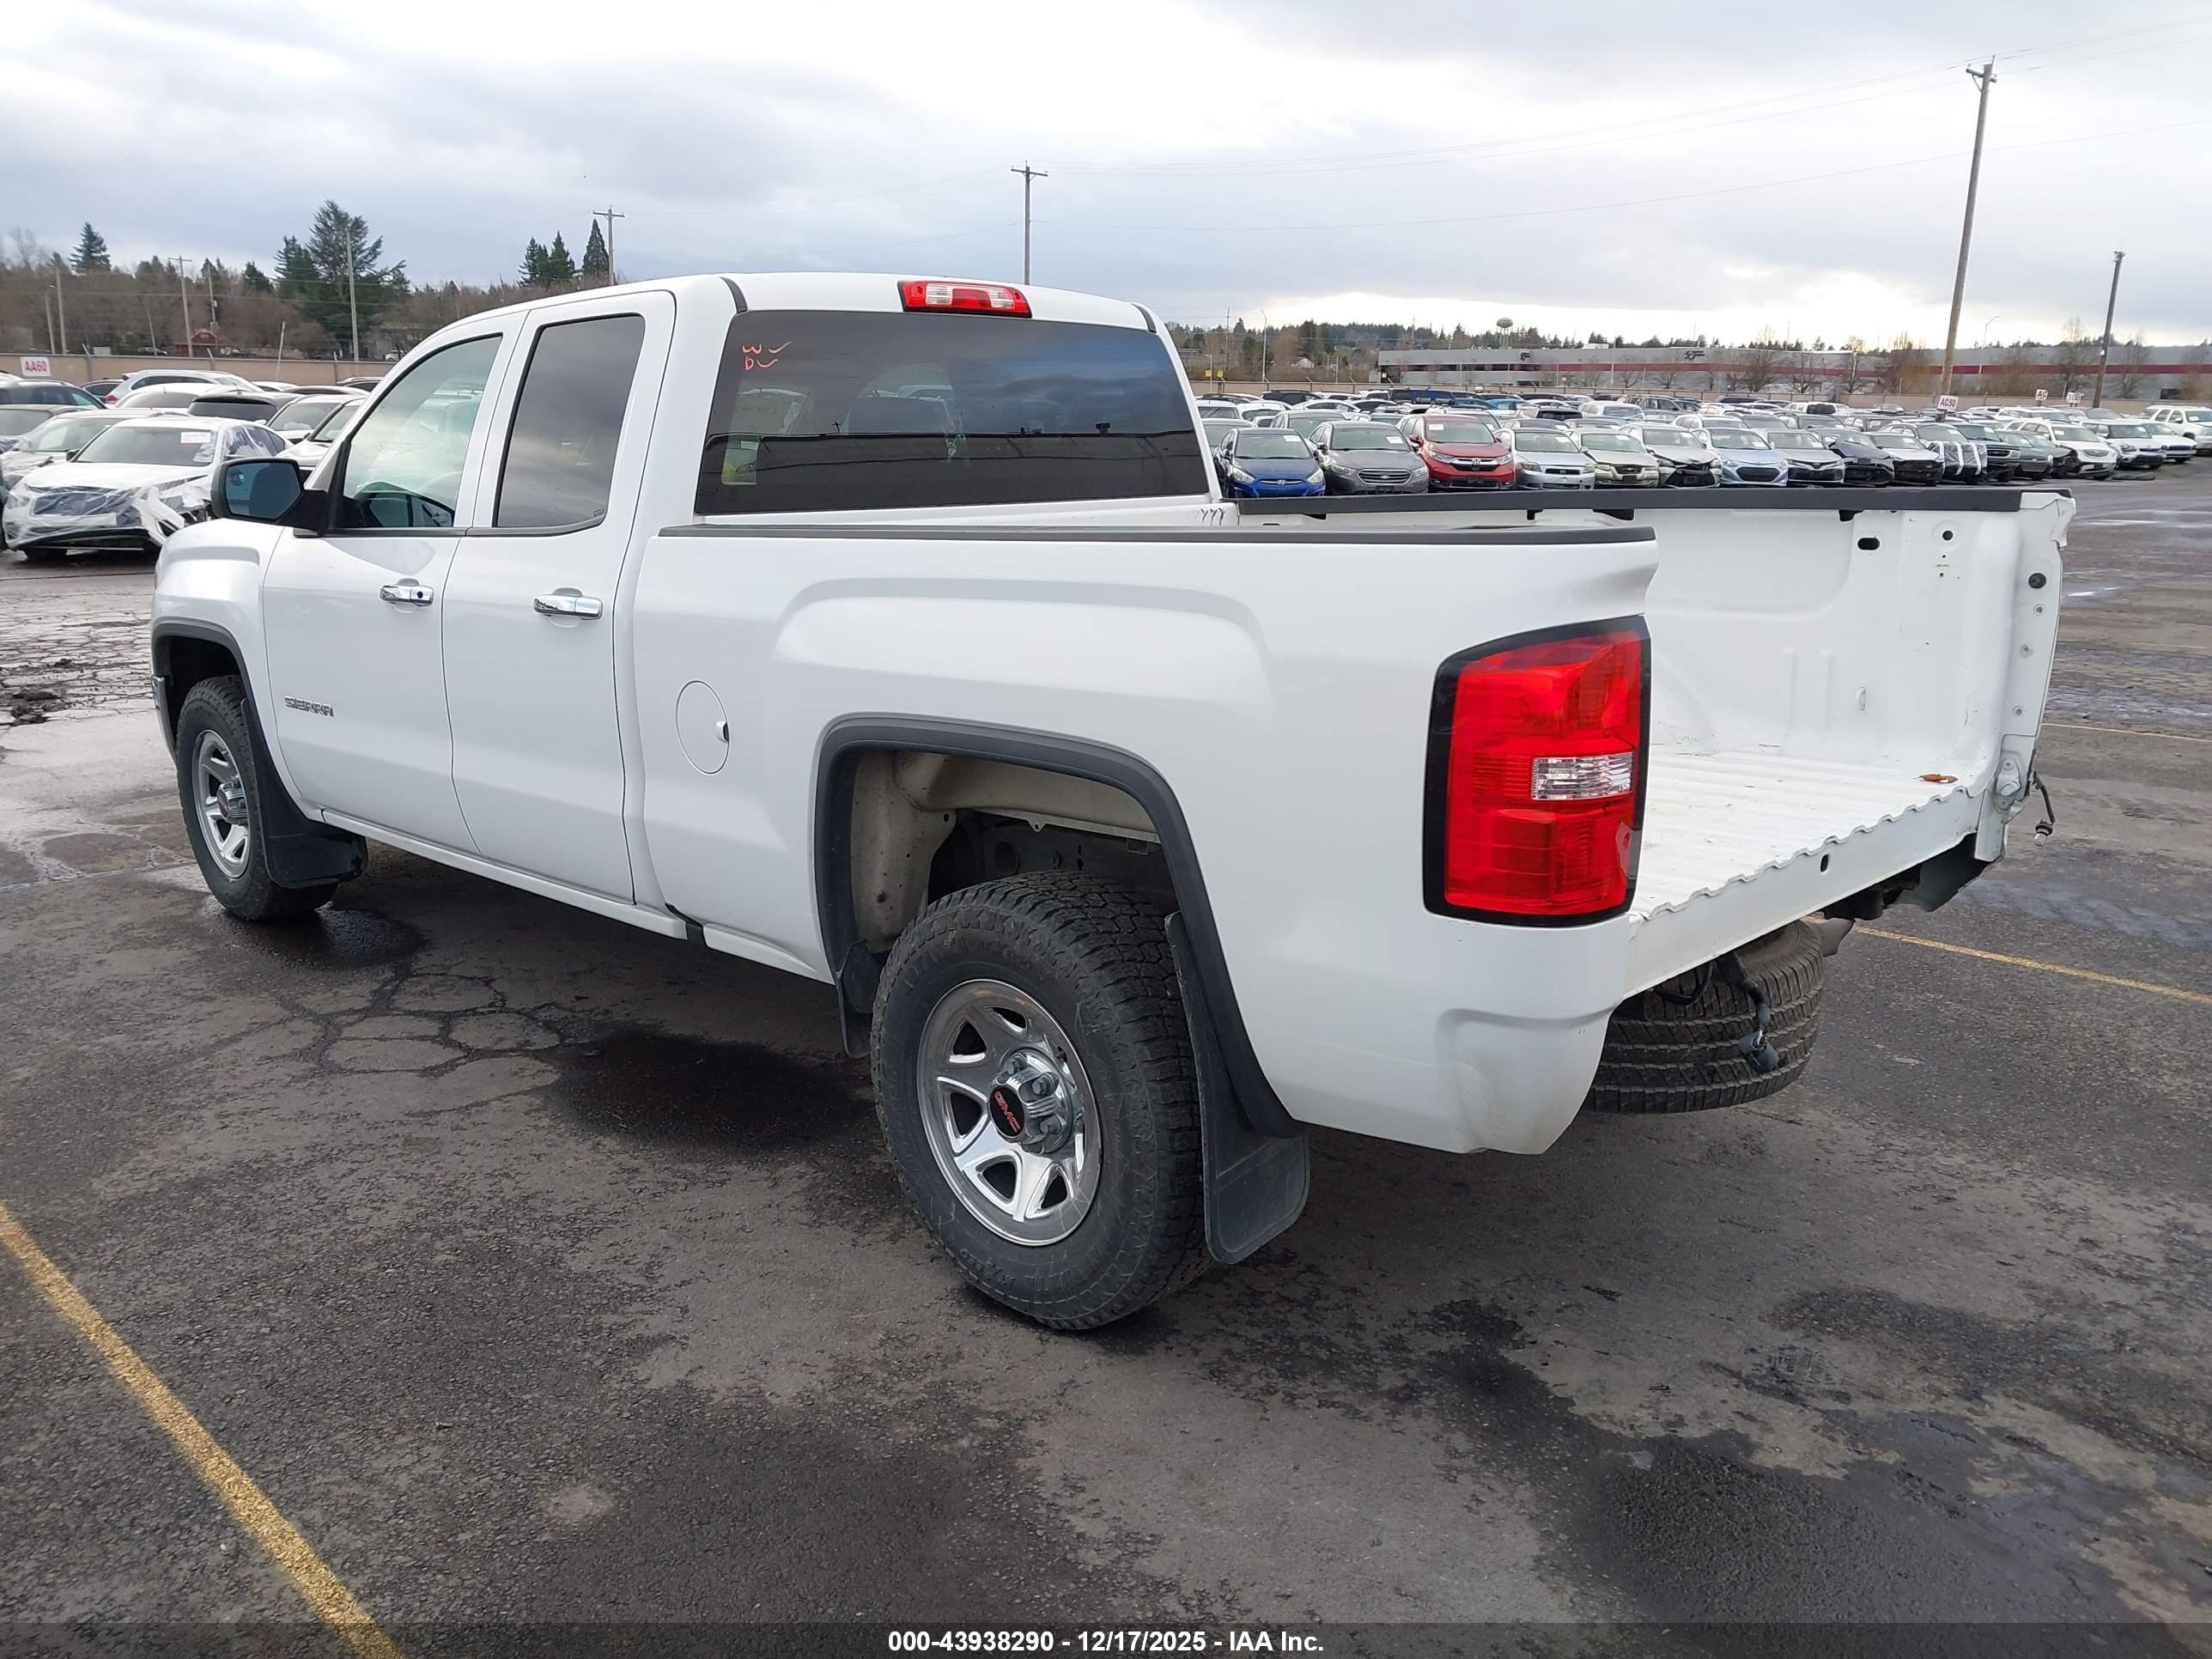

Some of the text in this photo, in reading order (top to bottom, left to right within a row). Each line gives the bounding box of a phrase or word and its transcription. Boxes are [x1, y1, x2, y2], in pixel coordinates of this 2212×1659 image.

[25, 361, 48, 372] AA60
[1940, 398, 1957, 407] AC50
[283, 696, 334, 717] SIERRA
[994, 1091, 1021, 1133] GMC
